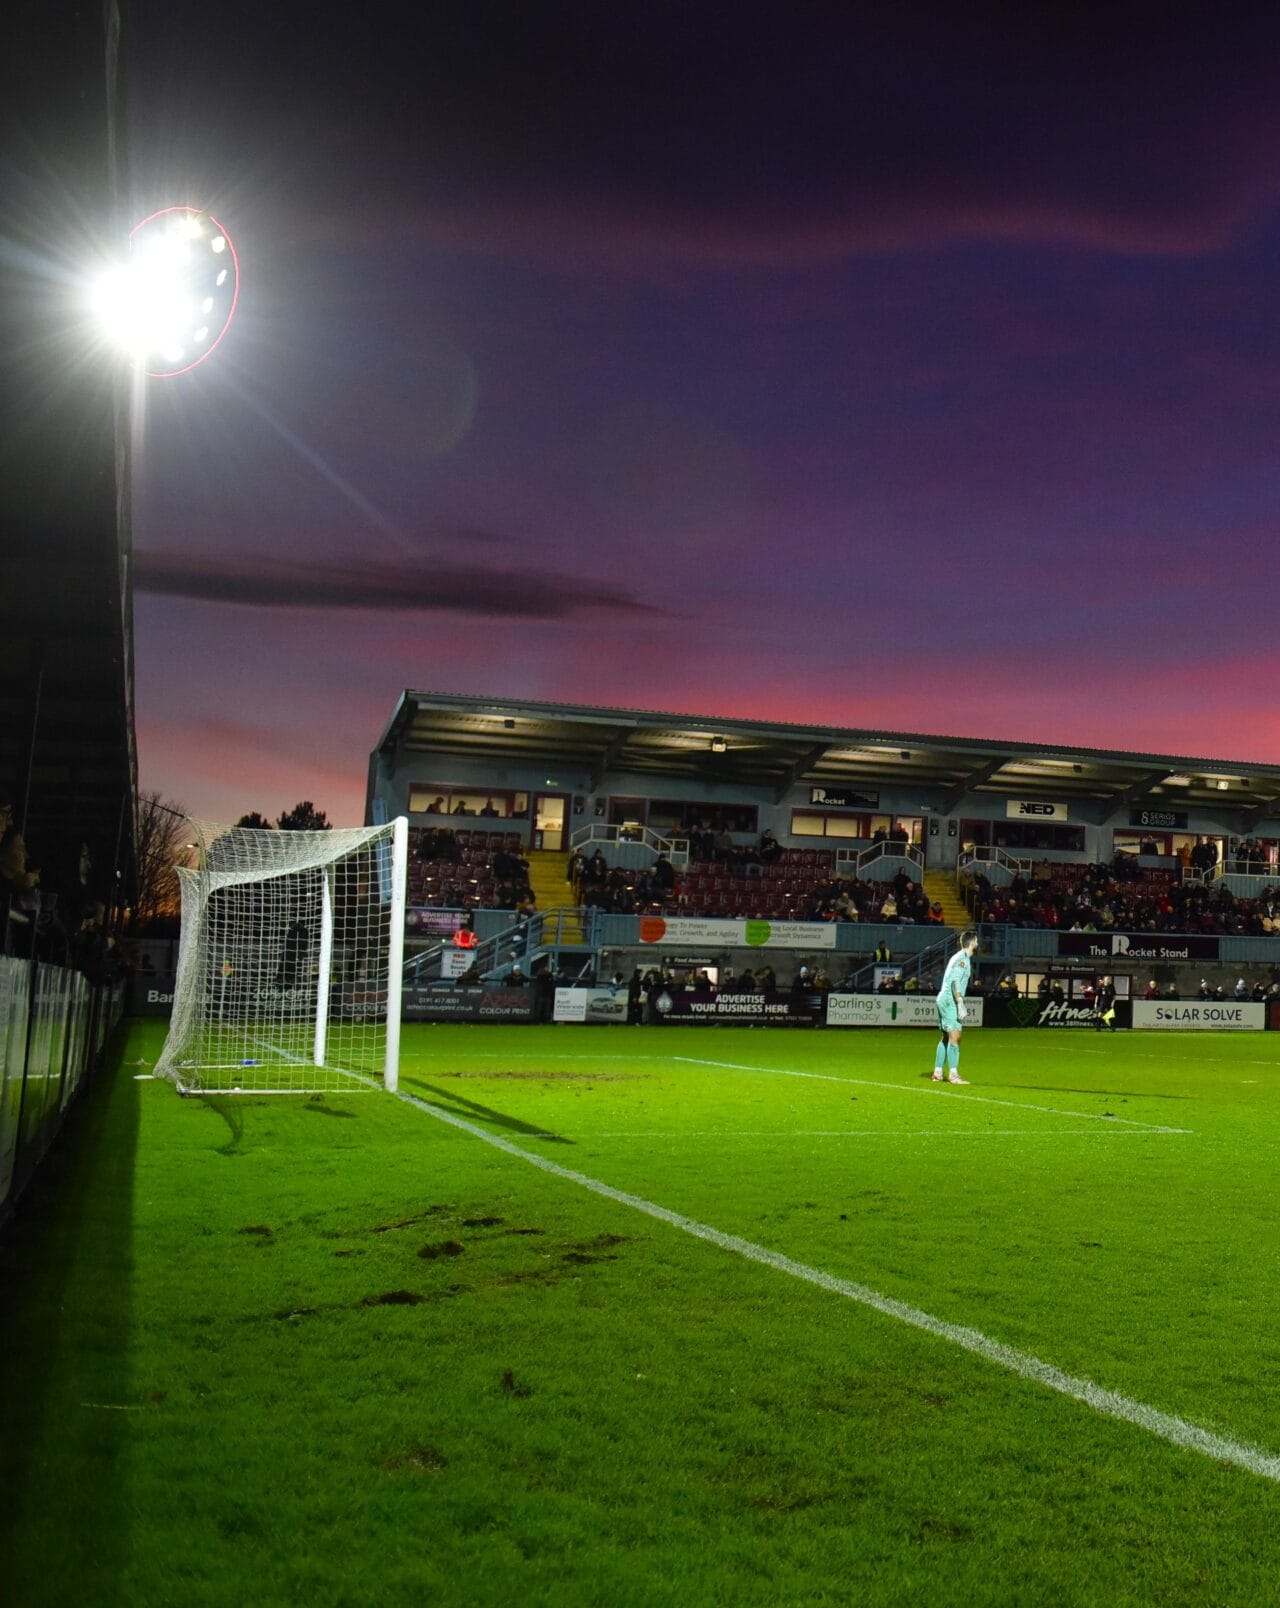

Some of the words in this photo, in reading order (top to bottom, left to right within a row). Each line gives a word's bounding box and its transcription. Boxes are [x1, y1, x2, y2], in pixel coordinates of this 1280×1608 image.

[812, 788, 845, 805] Rocket
[1019, 803, 1055, 815] NED
[1089, 946, 1107, 956] The
[1111, 935, 1156, 958] Rocket
[1160, 947, 1188, 958] Stand
[715, 994, 765, 1004] ADVERTISE
[829, 997, 882, 1012] Darling's
[479, 1007, 510, 1015] COLOUR
[690, 1003, 716, 1012] YOUR
[718, 1004, 763, 1013] BUSINESS
[765, 1004, 789, 1014] HERE
[914, 1007, 935, 1016] 0191
[1156, 1007, 1200, 1021] SOLAR
[1203, 1008, 1242, 1021] SOLVE
[829, 1011, 880, 1022] Pharmacy
